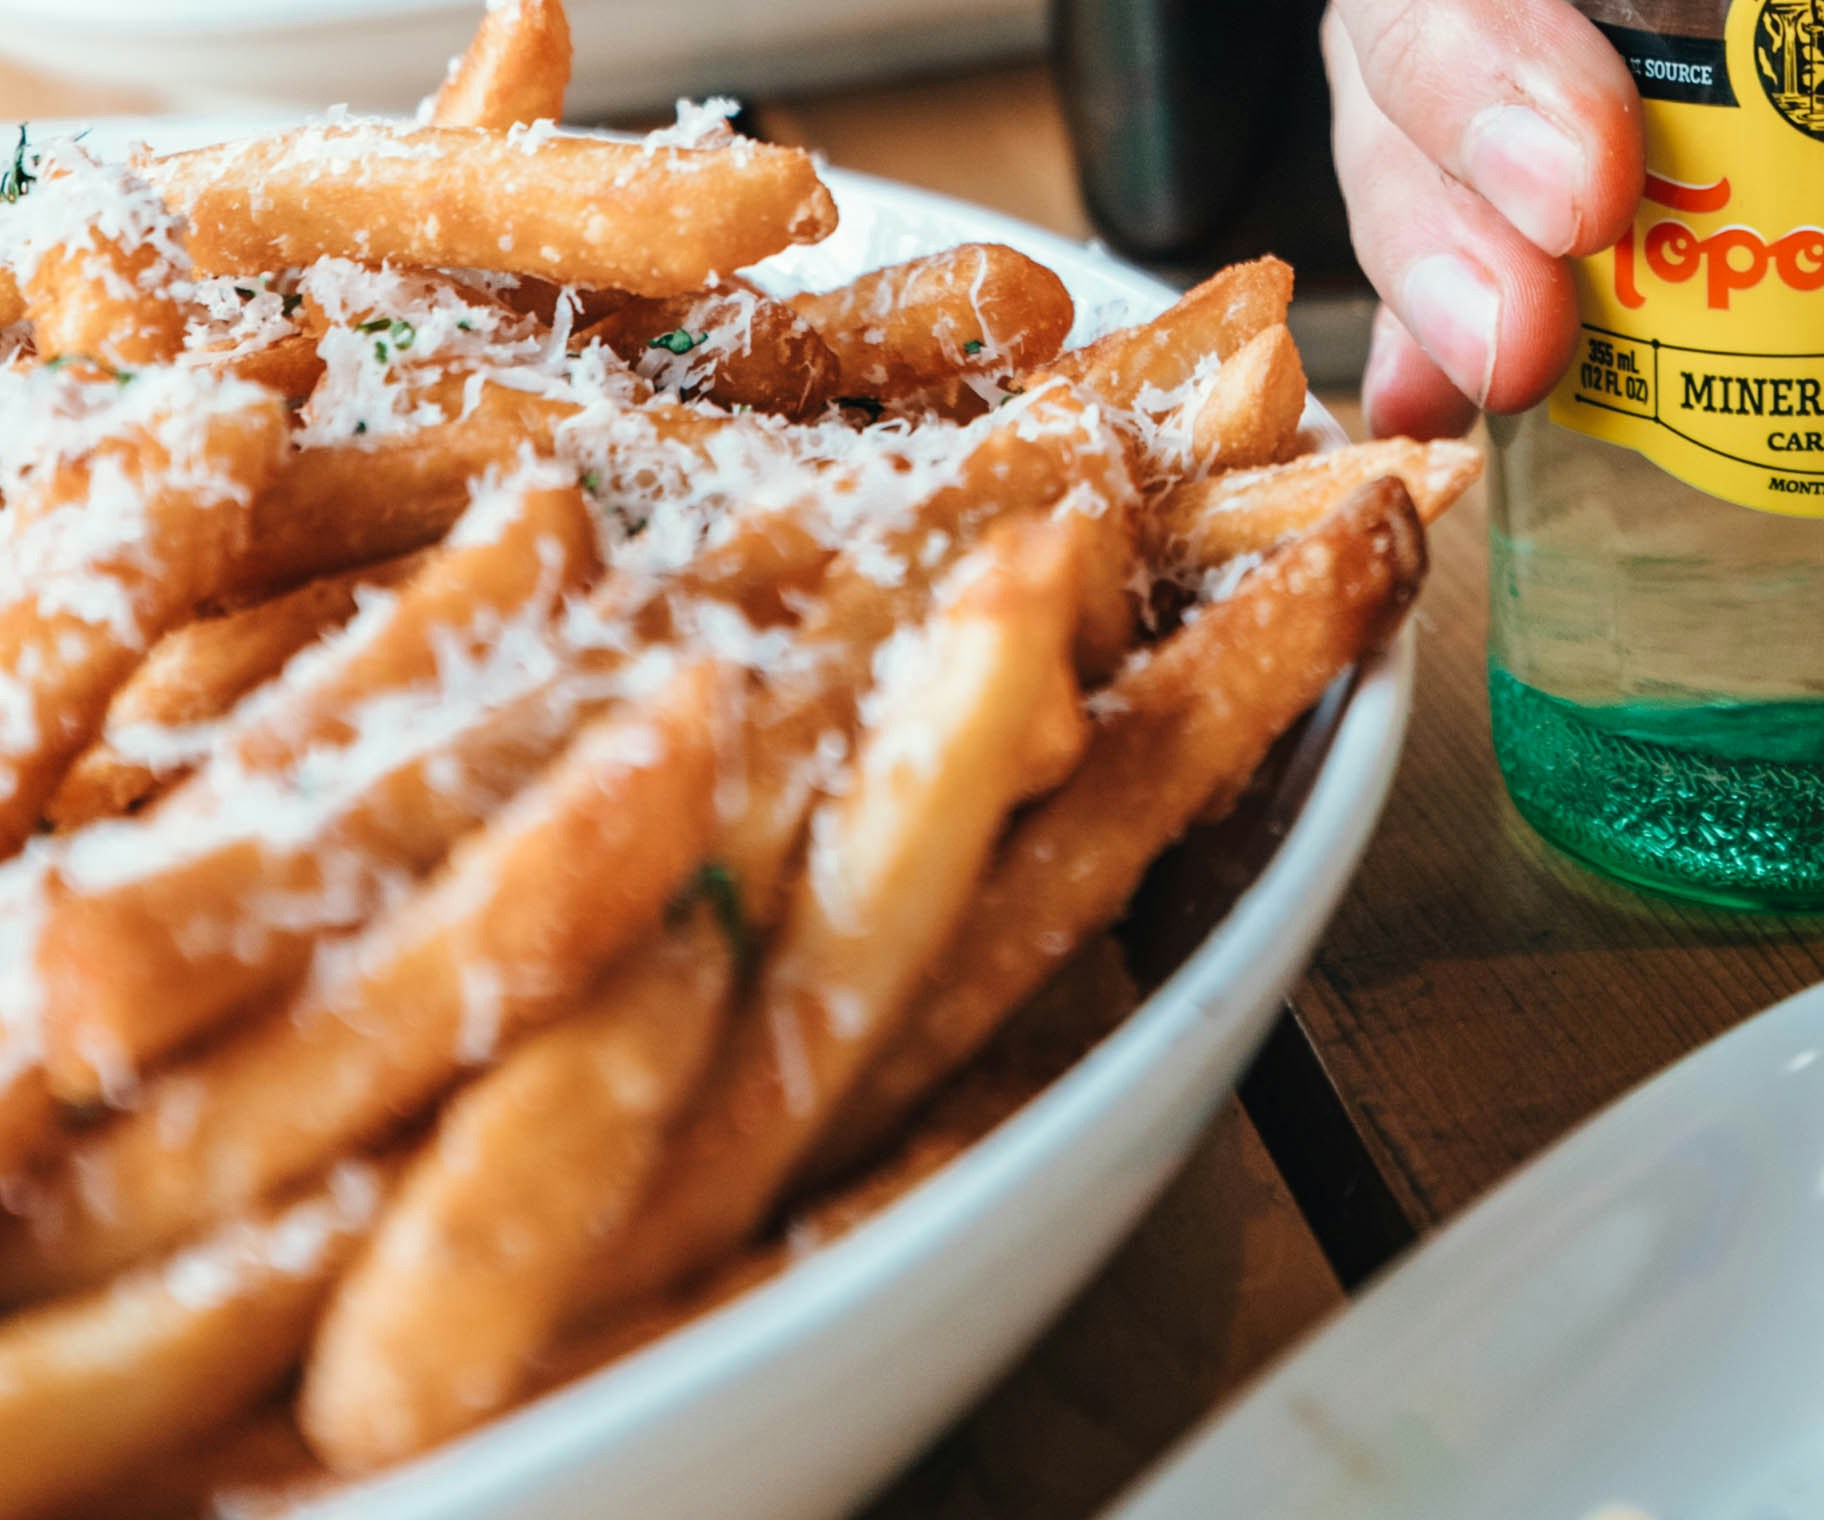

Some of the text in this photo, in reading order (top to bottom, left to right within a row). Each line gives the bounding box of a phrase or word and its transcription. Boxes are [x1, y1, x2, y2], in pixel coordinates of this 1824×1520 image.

[1645, 58, 1713, 86] SOURCE
[1588, 338, 1639, 374] 355 mL
[1581, 362, 1602, 391] (12
[1626, 375, 1649, 406] OZ)
